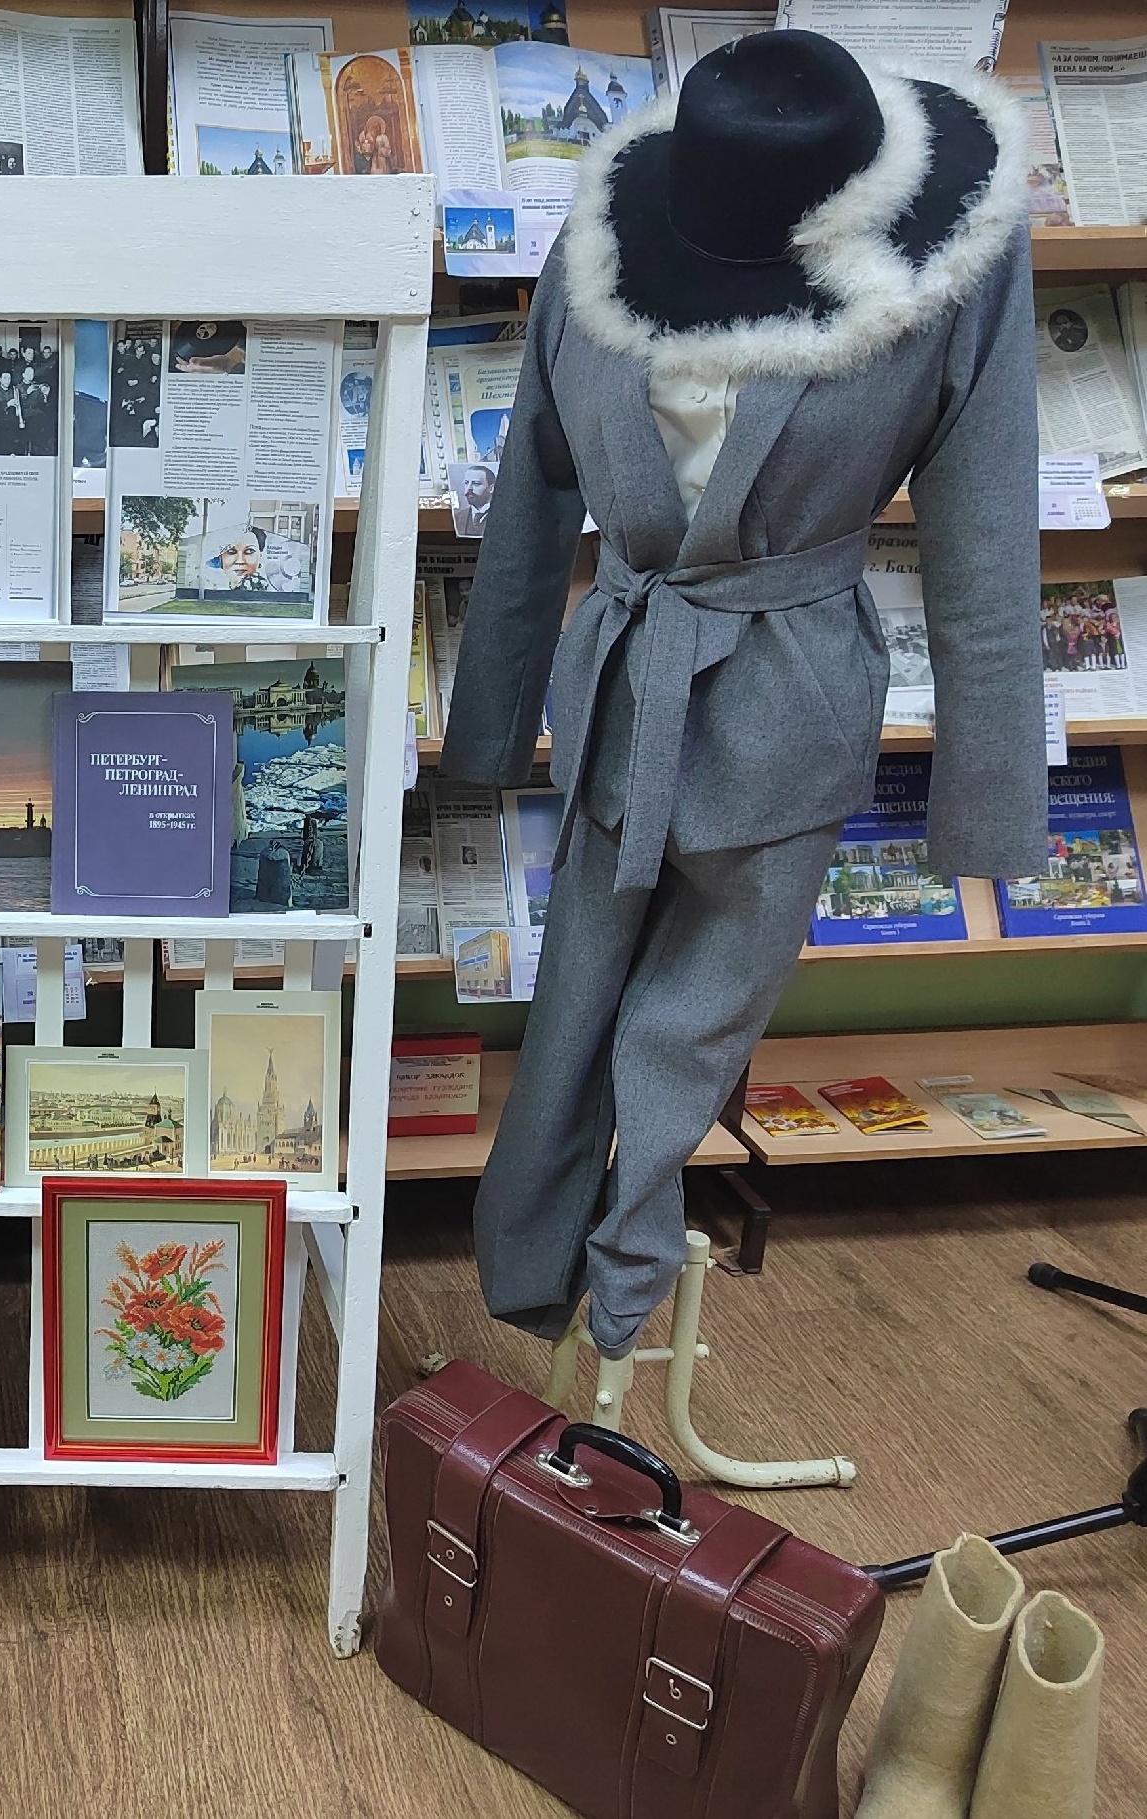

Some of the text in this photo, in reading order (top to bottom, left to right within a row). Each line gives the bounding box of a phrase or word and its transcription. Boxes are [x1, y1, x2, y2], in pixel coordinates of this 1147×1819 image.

[867, 532, 919, 550] бразов
[885, 559, 921, 573] Бала
[90, 753, 168, 766] ПЕТЕРБУРГ-
[104, 769, 184, 783] ПЕТРОГРАД-
[119, 784, 198, 797] ЛЕНИНГРАД
[155, 811, 196, 821] открытках
